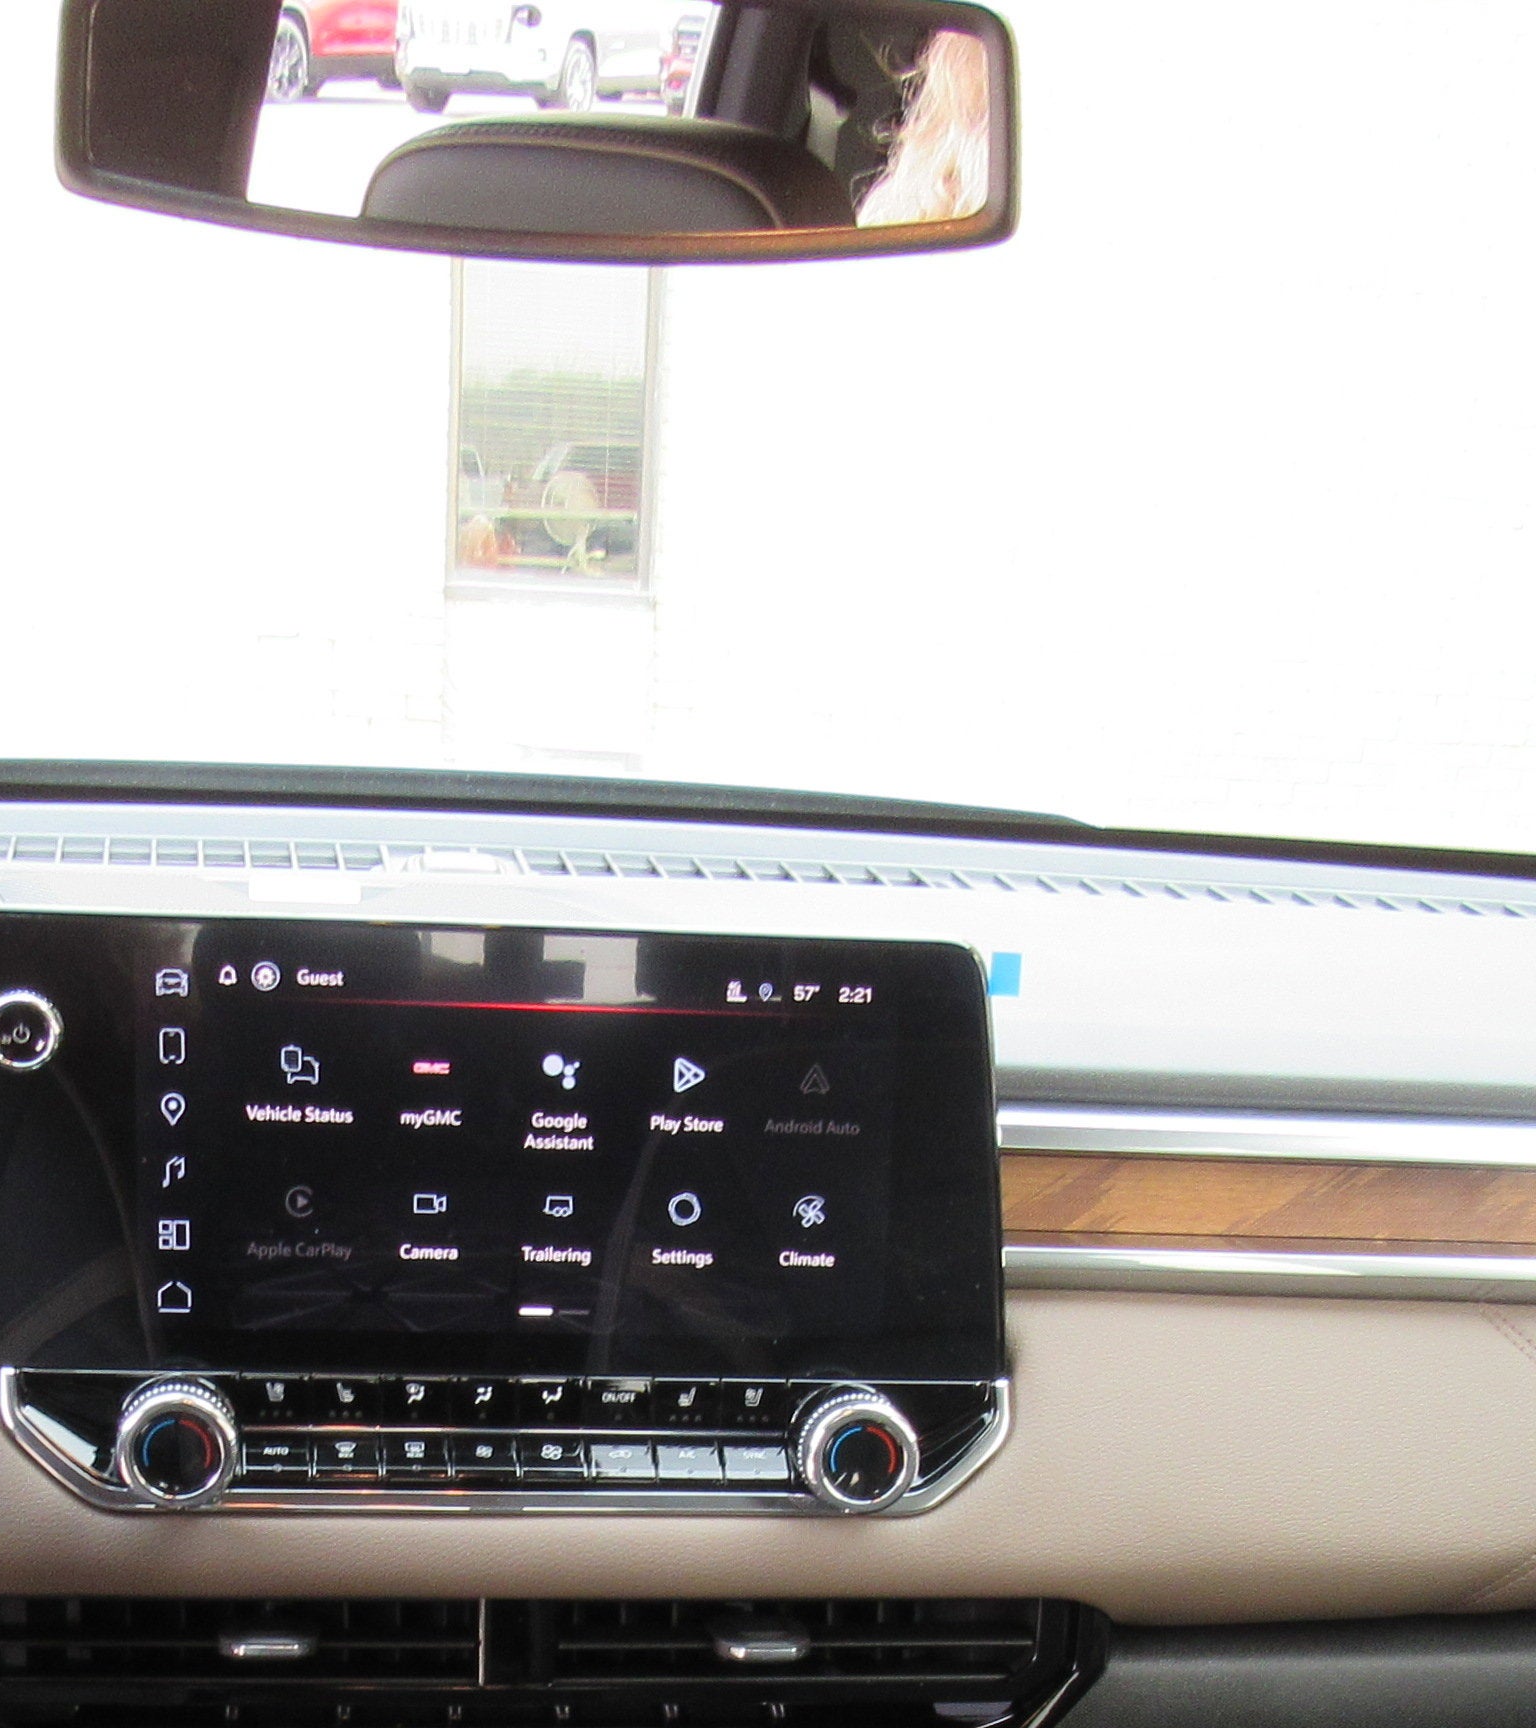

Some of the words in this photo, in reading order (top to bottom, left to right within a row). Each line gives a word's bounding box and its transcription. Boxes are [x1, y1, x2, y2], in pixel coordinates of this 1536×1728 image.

[296, 968, 345, 988] Guest
[838, 987, 872, 1004] 2:21
[245, 1105, 302, 1123] Vehicle
[304, 1106, 354, 1125] Status
[400, 1110, 462, 1128] myGMC
[531, 1112, 588, 1133] Google
[650, 1115, 682, 1134] Play
[683, 1116, 724, 1133] Store
[765, 1118, 823, 1136] Android
[826, 1120, 861, 1136] Auto
[524, 1134, 594, 1151] Assistant
[246, 1240, 291, 1260] Apple
[294, 1241, 352, 1262] CarPlay
[399, 1243, 459, 1260] Camera
[521, 1245, 592, 1267] Trailering
[651, 1248, 714, 1269] Settings
[778, 1251, 836, 1268] Climate
[601, 1391, 636, 1404] ON/OFF
[263, 1446, 289, 1457] AUTO
